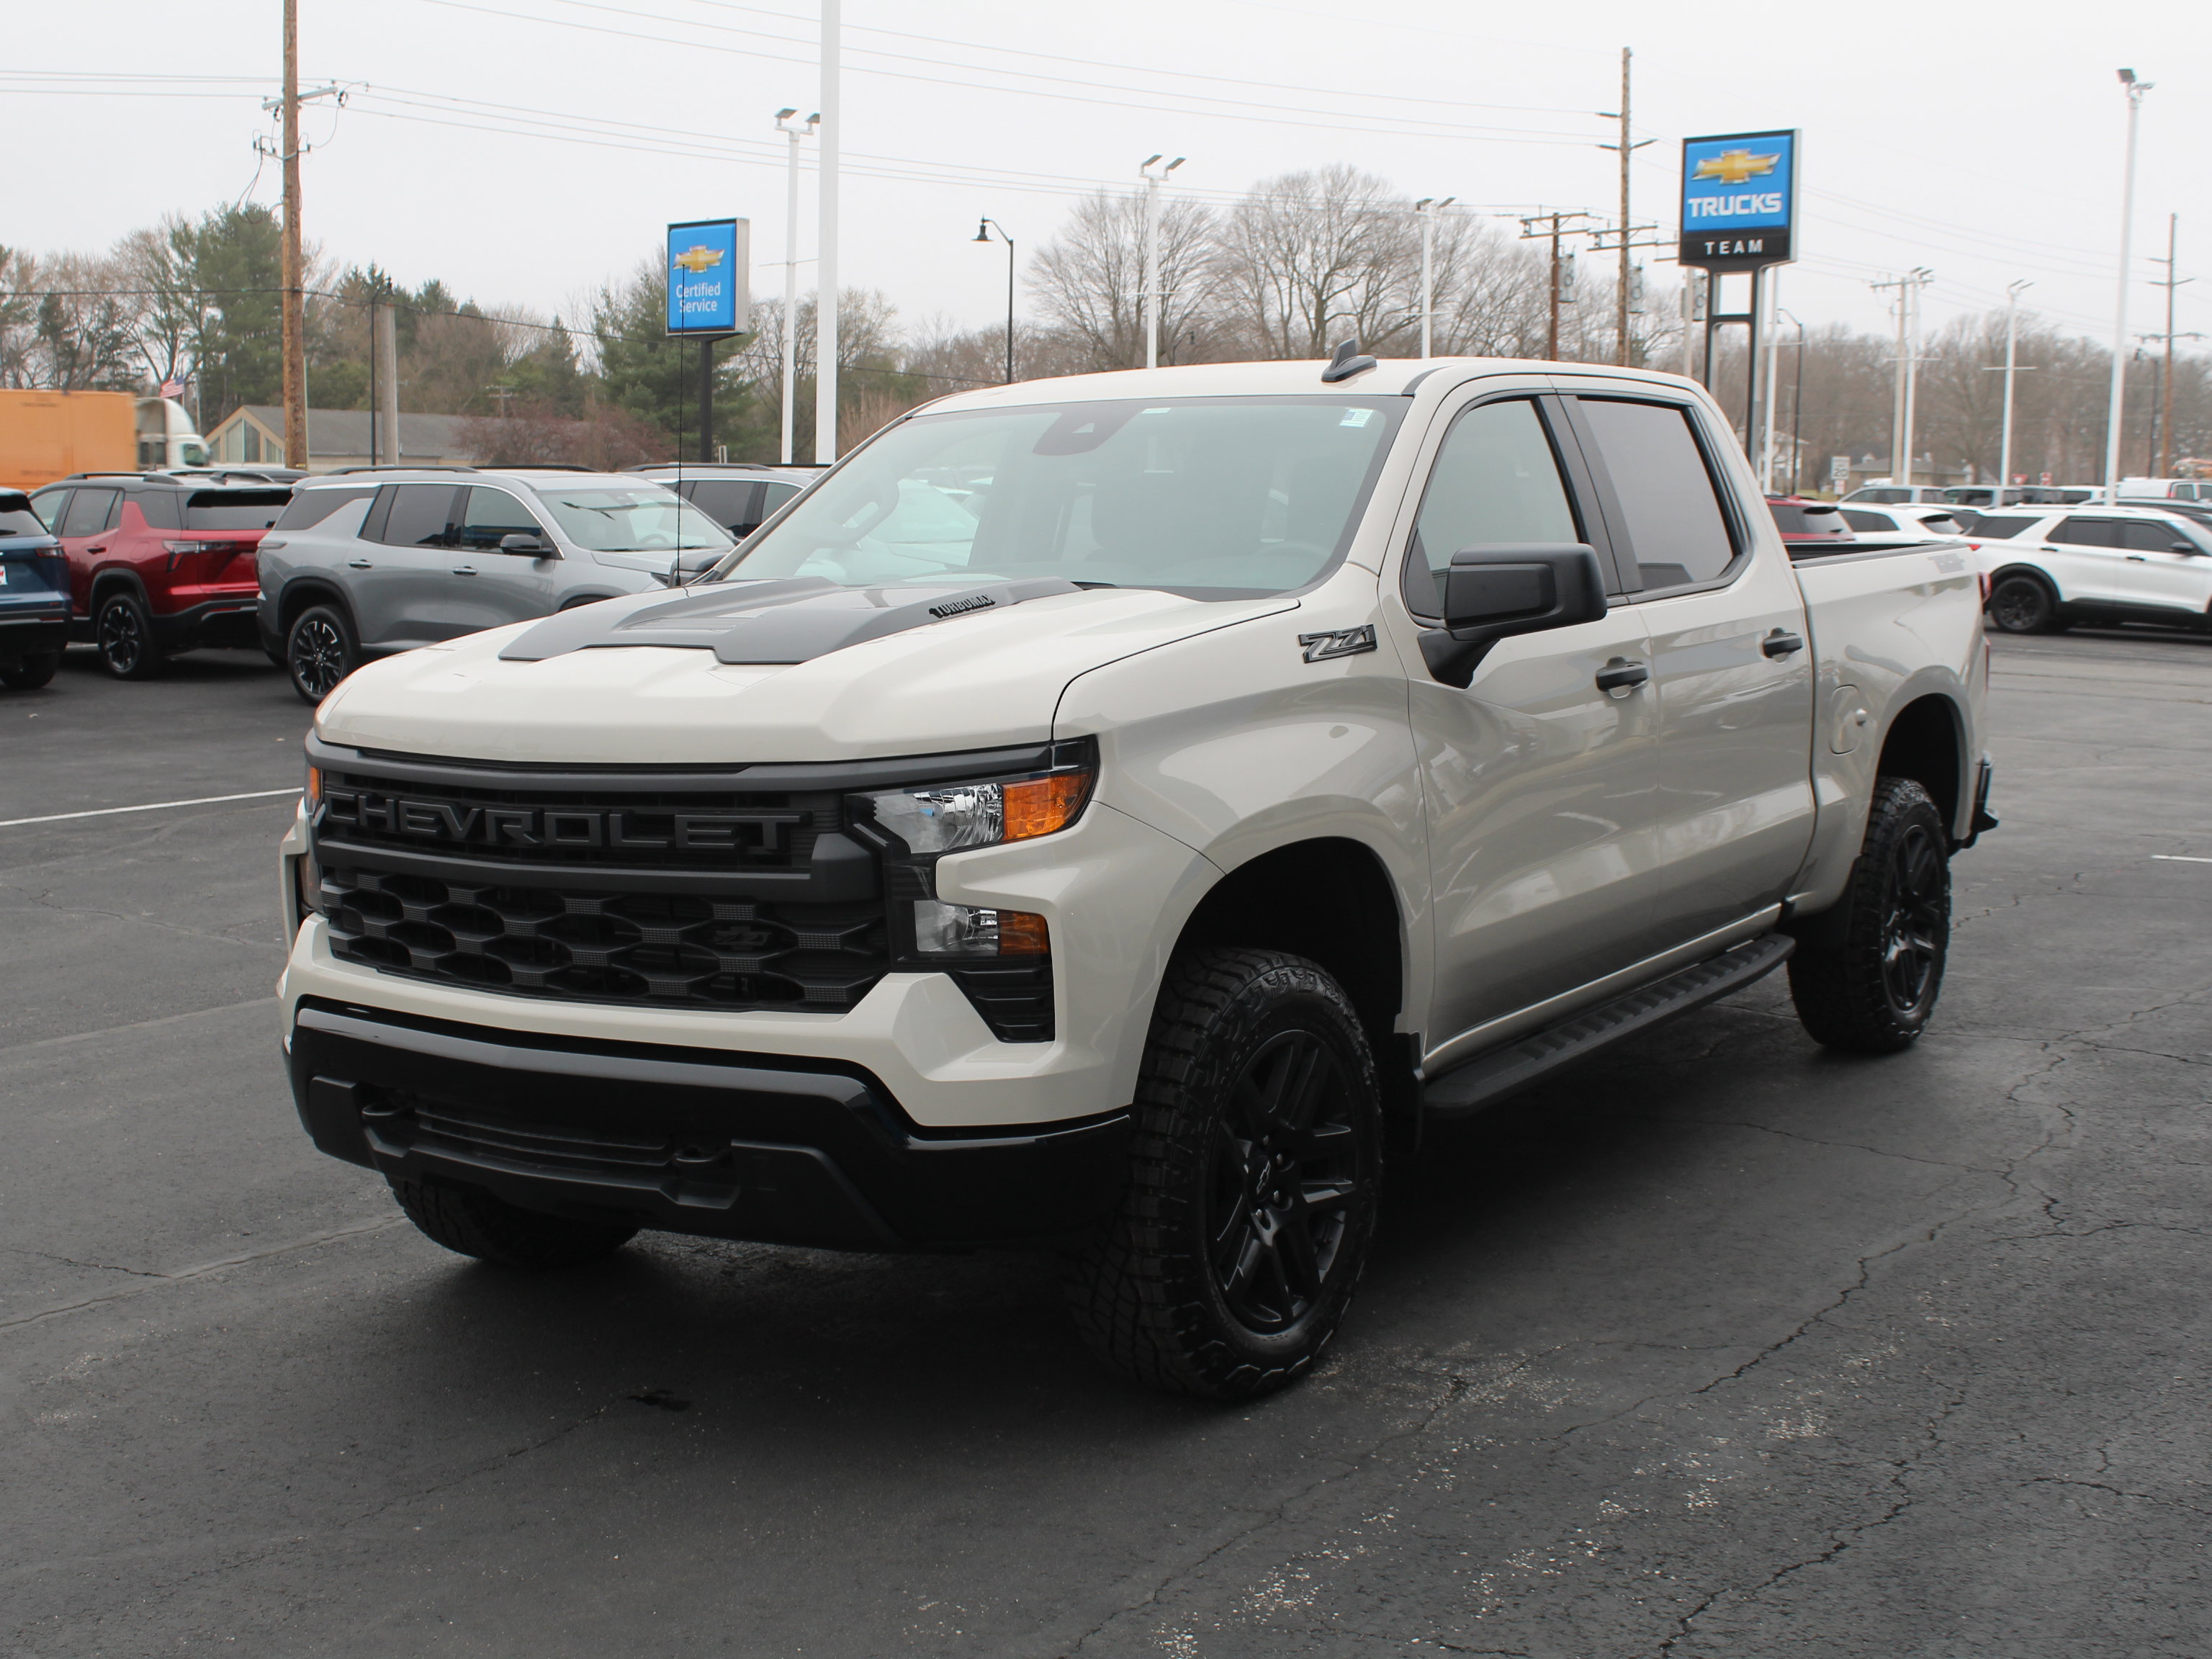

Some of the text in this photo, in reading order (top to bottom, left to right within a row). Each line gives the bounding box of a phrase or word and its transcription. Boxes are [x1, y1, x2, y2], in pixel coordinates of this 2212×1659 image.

[1688, 192, 1782, 217] TRUCKS
[1704, 238, 1763, 255] TEAM
[676, 282, 721, 298] Certified
[679, 299, 717, 313] Service
[1833, 468, 1849, 477] 20
[929, 594, 996, 619] TURBOMAX
[1298, 624, 1377, 664] Z71
[323, 790, 806, 853] CHEVROLET
